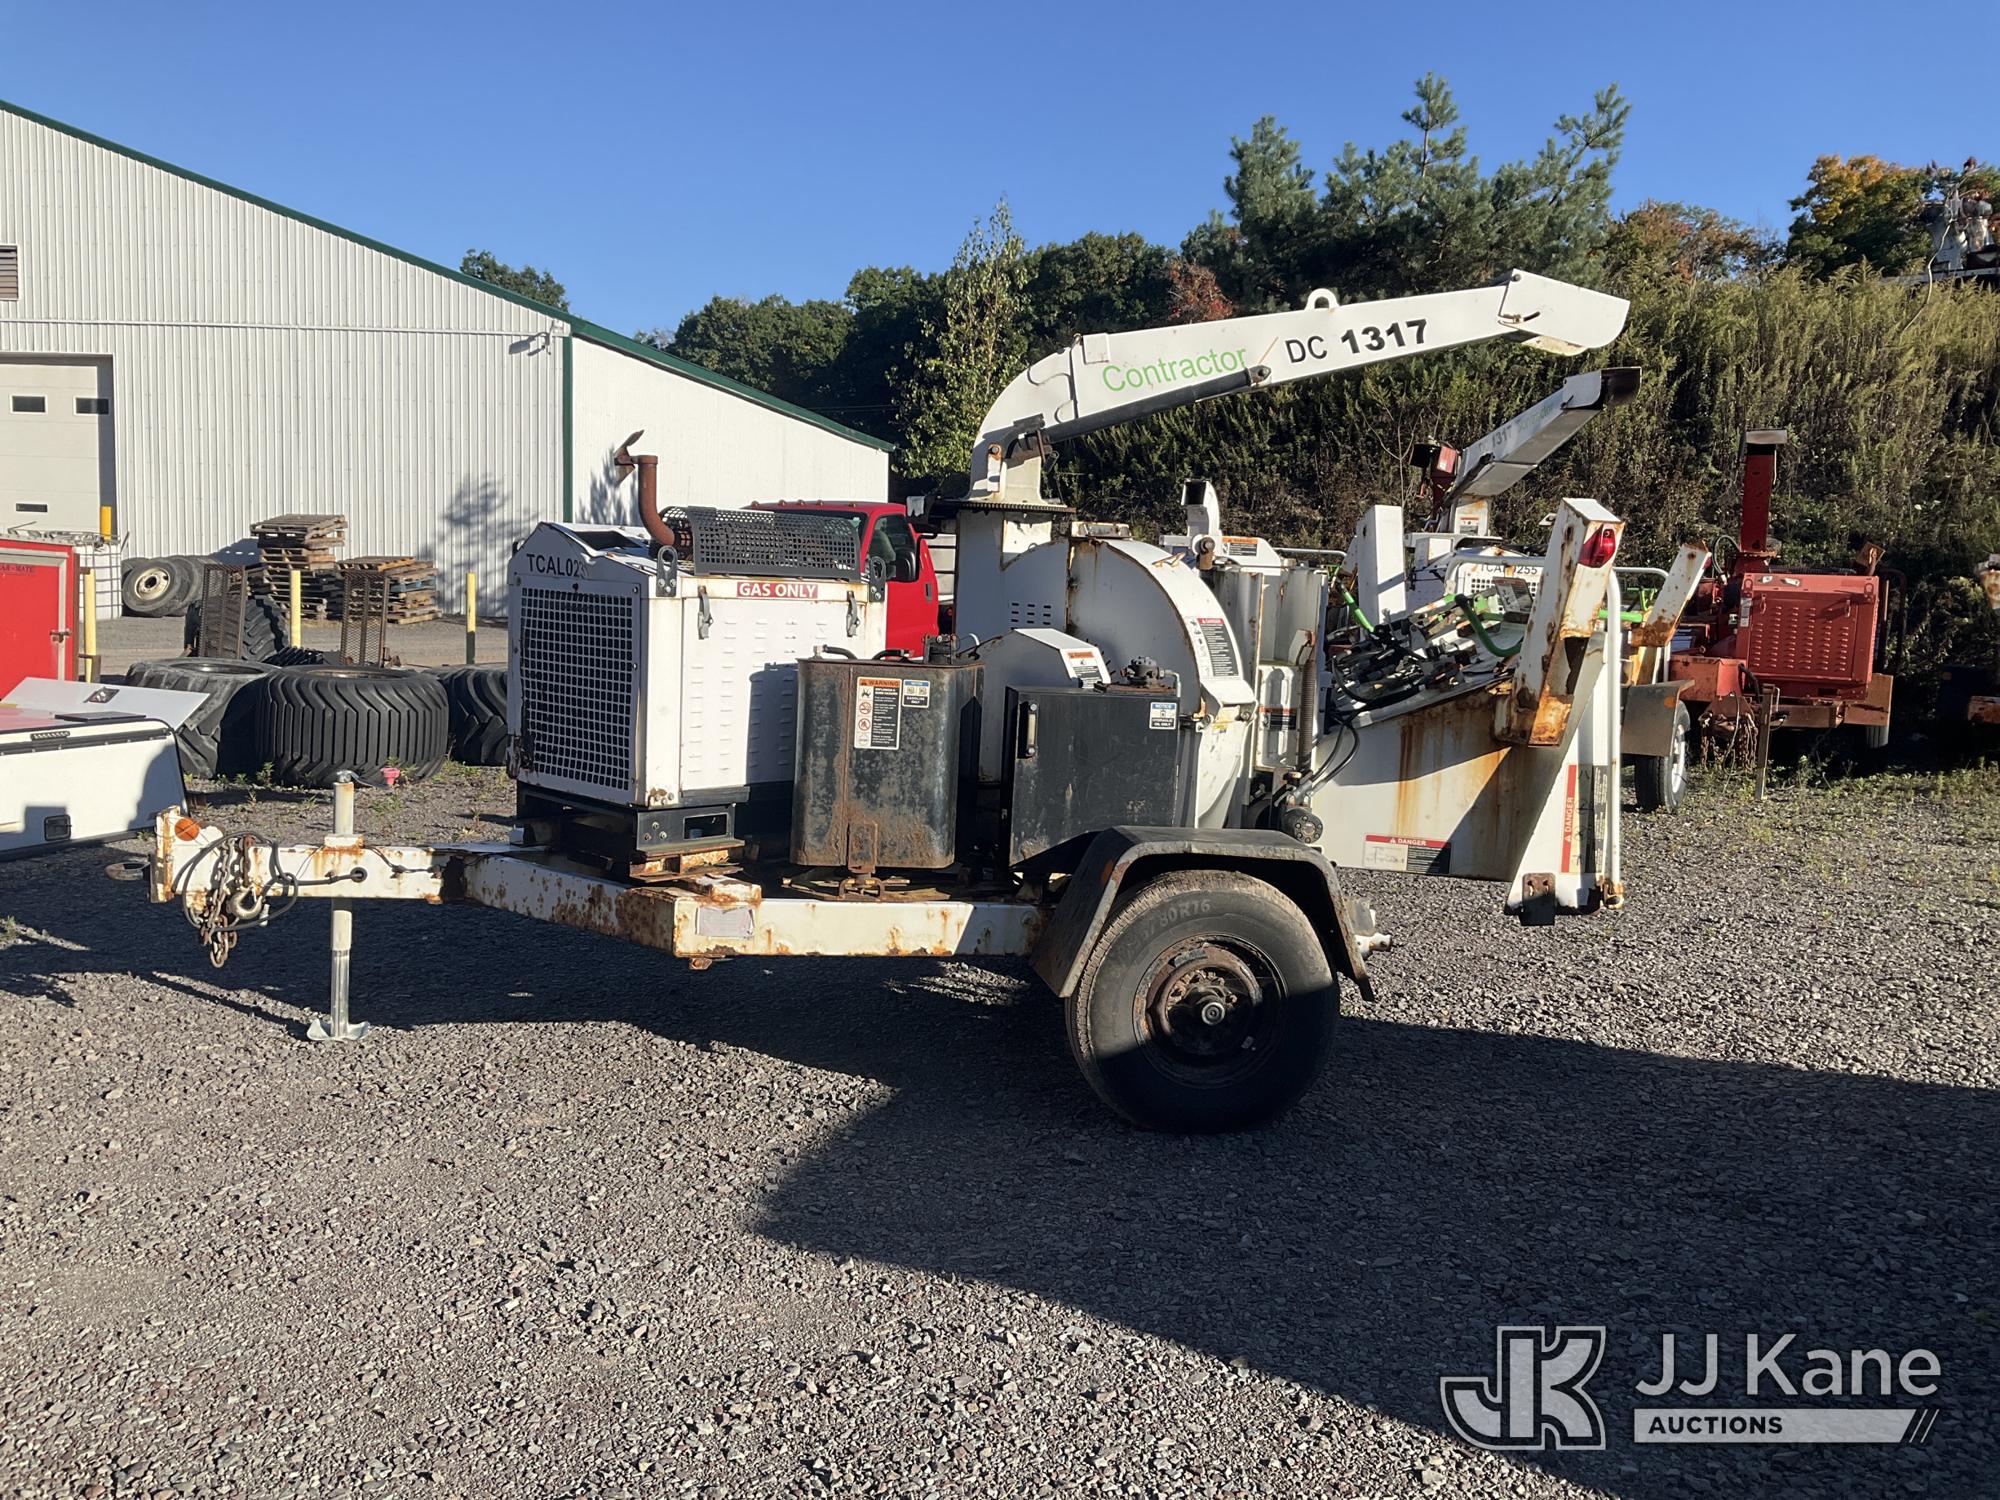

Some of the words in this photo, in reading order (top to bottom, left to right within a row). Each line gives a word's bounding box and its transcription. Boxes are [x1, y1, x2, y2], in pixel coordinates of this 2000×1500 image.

[1285, 335, 1328, 363] DC
[1340, 318, 1427, 354] 1317
[1102, 348, 1246, 392] Contractor
[739, 582, 771, 597] GAS
[775, 583, 816, 598] ONLY
[1564, 797, 1574, 832] DANGER
[1398, 838, 1427, 846] DANGER
